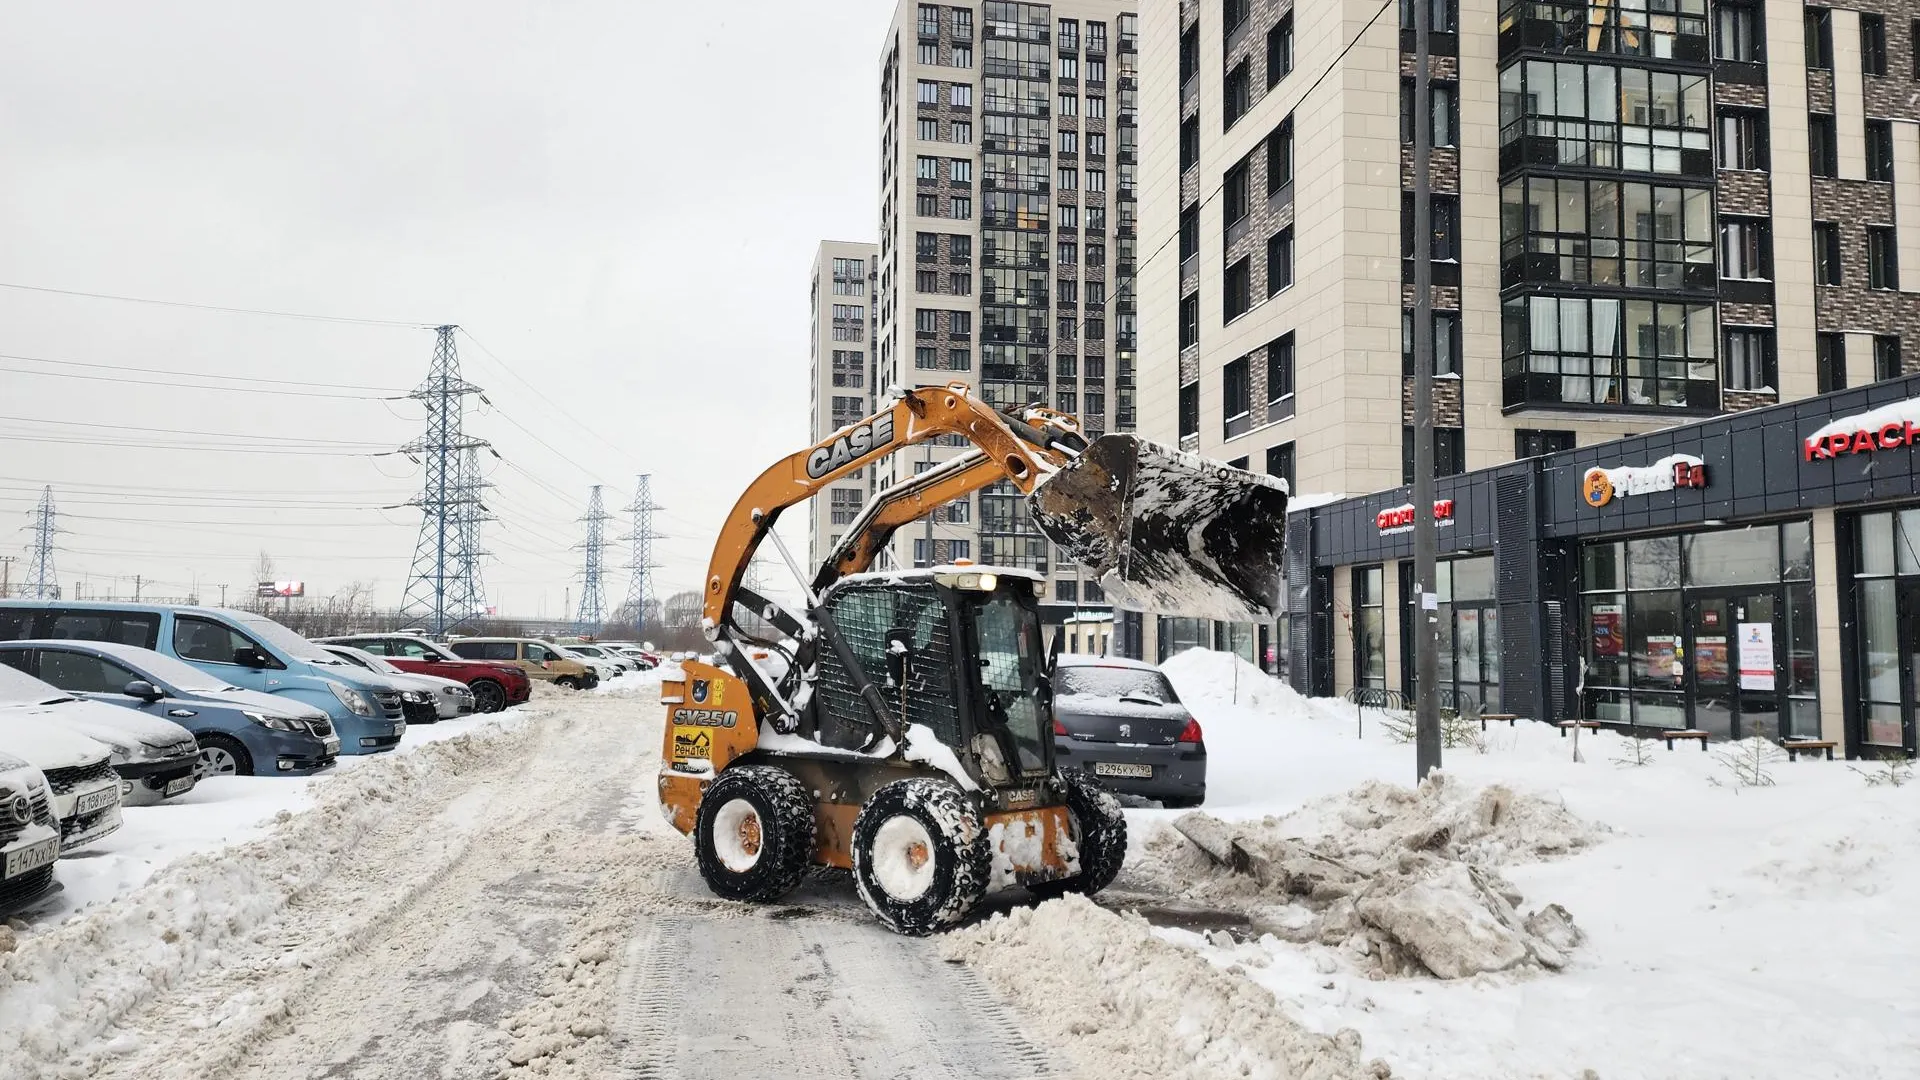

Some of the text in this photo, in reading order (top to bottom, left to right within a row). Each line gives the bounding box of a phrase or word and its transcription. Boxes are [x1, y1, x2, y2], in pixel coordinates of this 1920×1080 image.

[807, 410, 894, 479] CASE
[673, 708, 738, 729] SV250
[674, 744, 710, 757] РендТех
[1008, 789, 1036, 803] CASE
